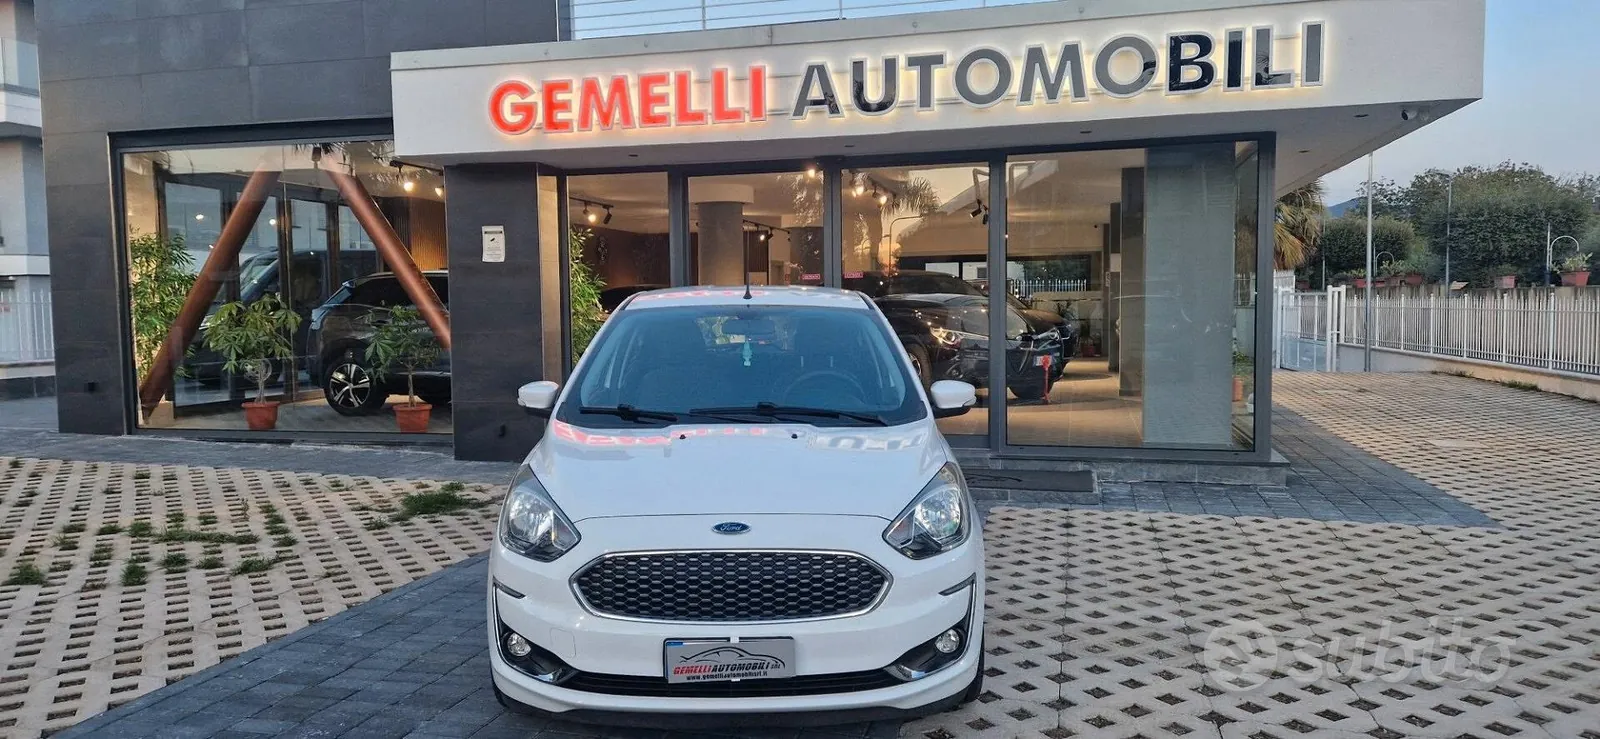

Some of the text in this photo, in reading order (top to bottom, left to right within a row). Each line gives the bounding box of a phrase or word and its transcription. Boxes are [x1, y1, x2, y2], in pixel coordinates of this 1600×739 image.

[488, 20, 1325, 135] GEMELLI AUTOMOBILI
[720, 523, 742, 531] Ford
